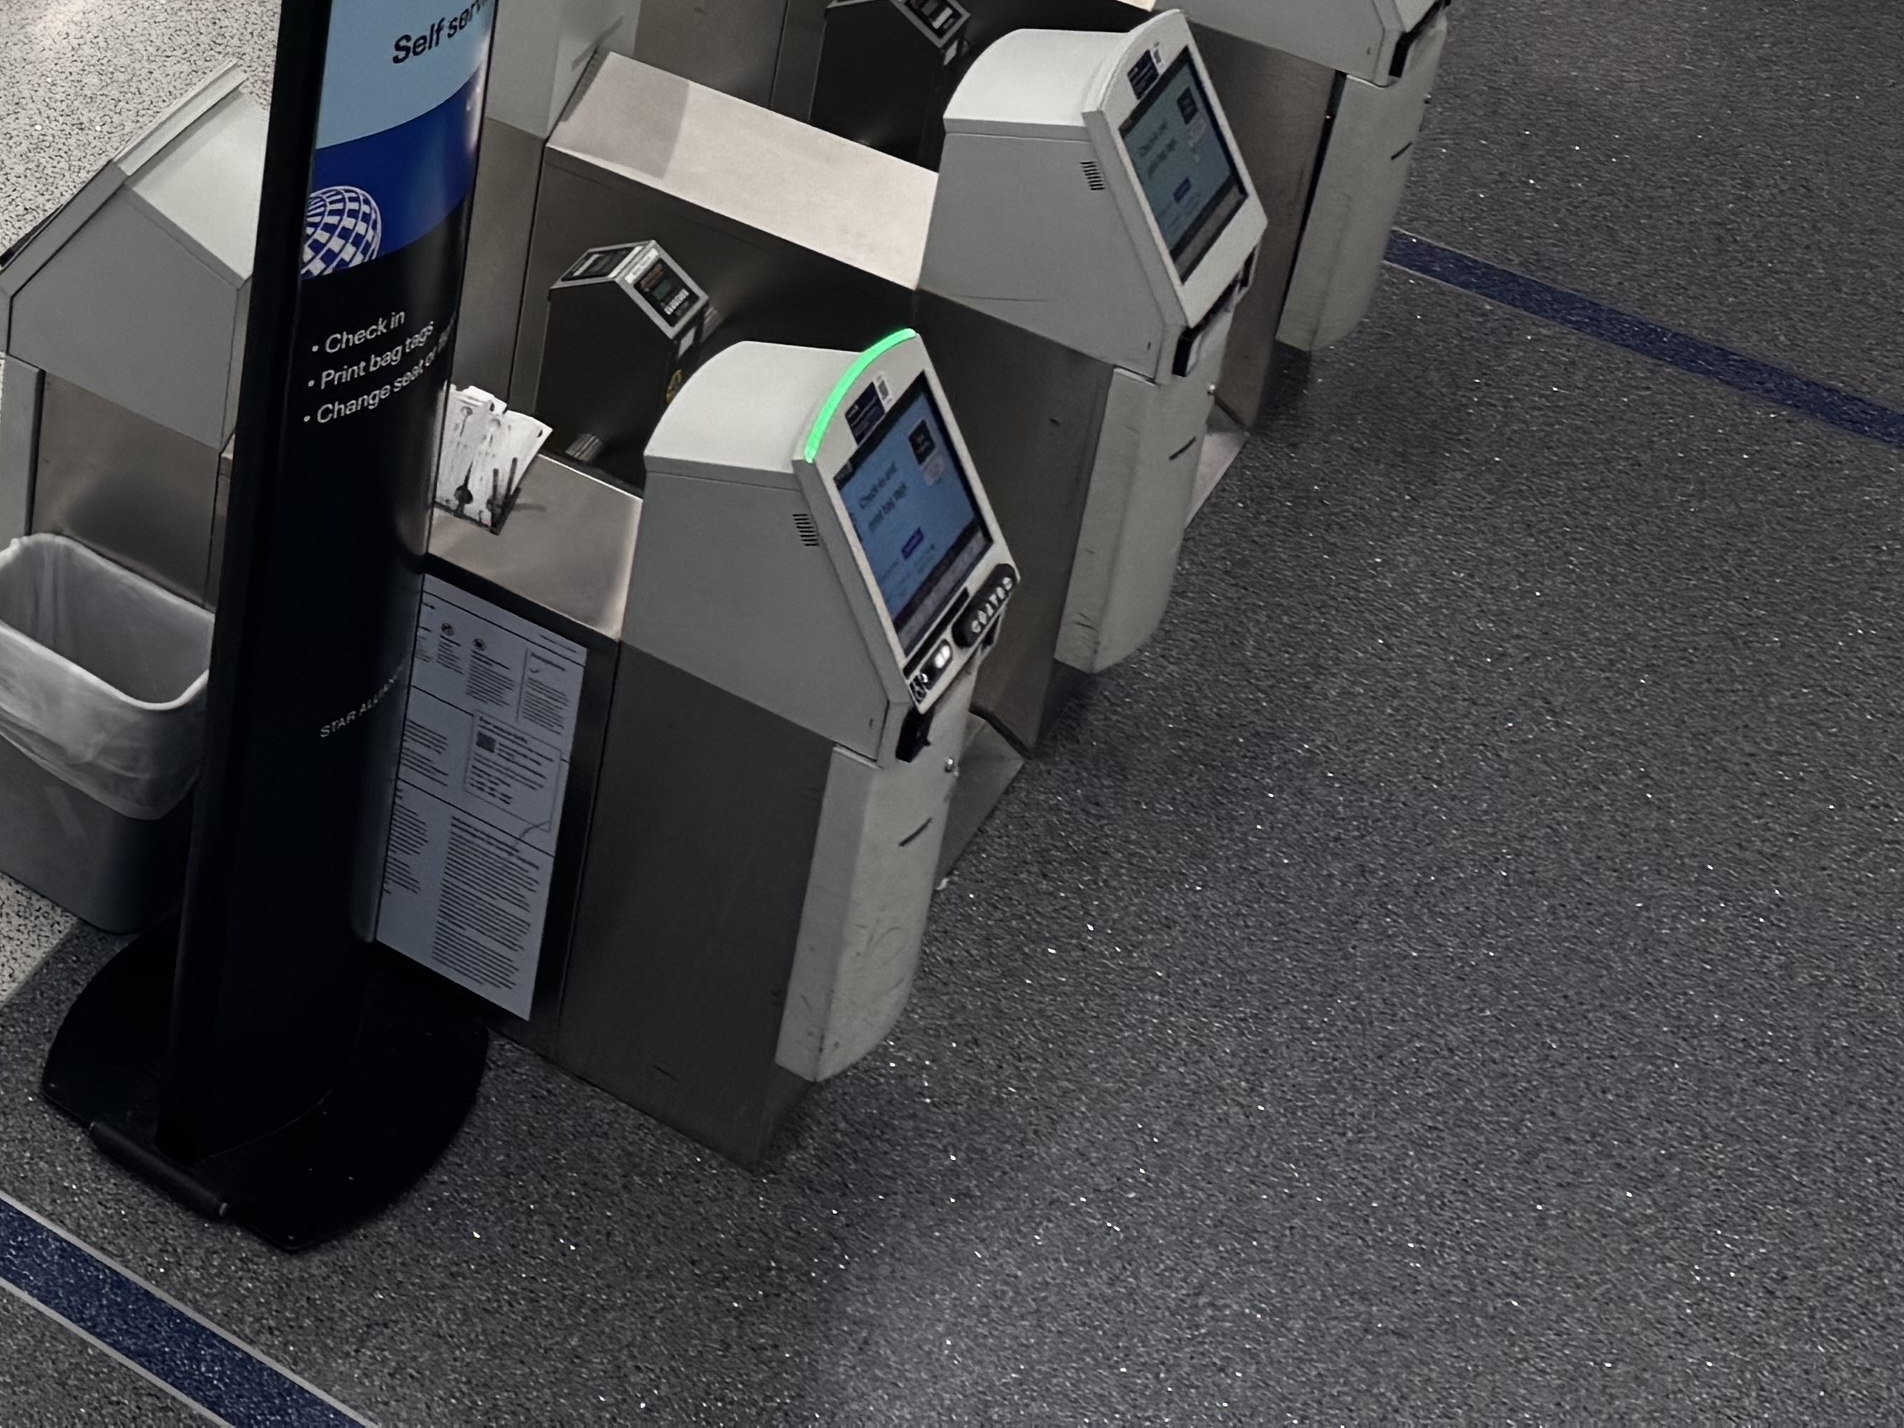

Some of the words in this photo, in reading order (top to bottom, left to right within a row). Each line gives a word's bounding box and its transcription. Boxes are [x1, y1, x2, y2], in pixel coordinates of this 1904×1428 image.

[392, 16, 446, 65] Self
[319, 359, 367, 391] Print
[369, 344, 403, 373] bag
[404, 320, 435, 355] tags
[324, 315, 388, 355] Check
[388, 309, 406, 331] in
[316, 380, 392, 424] Change
[392, 356, 425, 394] seat
[319, 709, 358, 739] STAR
